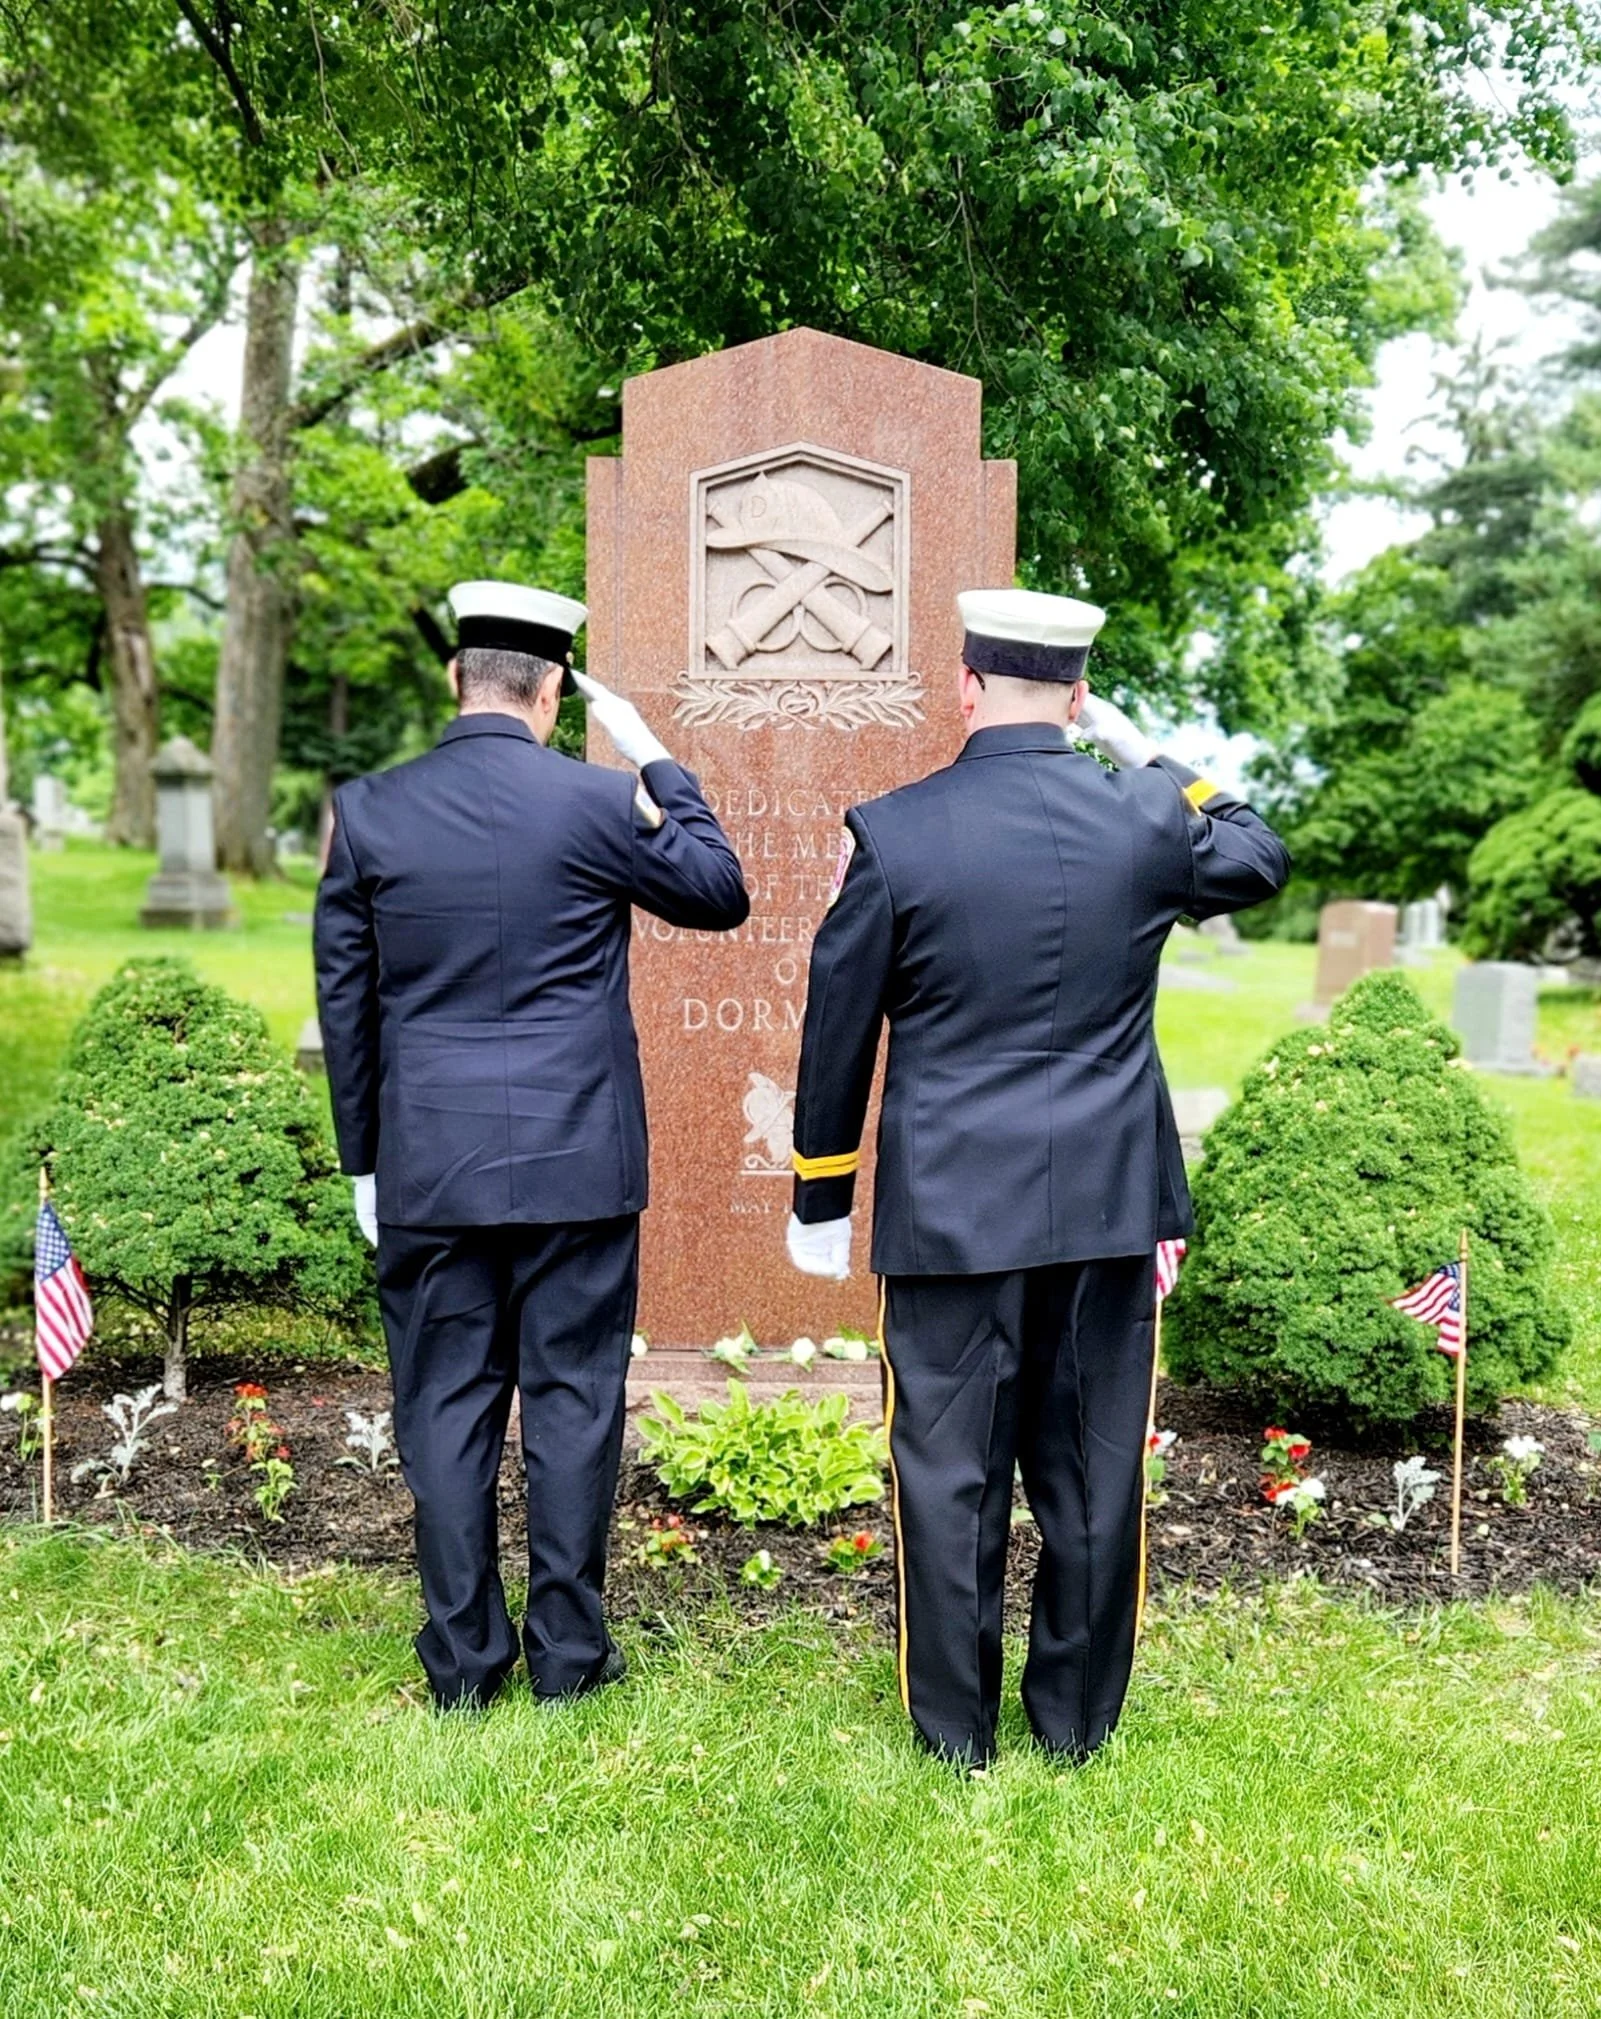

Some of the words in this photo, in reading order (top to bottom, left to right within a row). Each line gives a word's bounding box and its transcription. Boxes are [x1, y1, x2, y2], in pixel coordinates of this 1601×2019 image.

[701, 789, 890, 816] DEDICAT
[726, 832, 777, 858] HE
[791, 832, 841, 858] ME
[742, 873, 778, 900] OF
[792, 873, 834, 900] TH
[775, 958, 809, 985] O
[683, 998, 807, 1031] DORM
[729, 1199, 772, 1214] MAY
